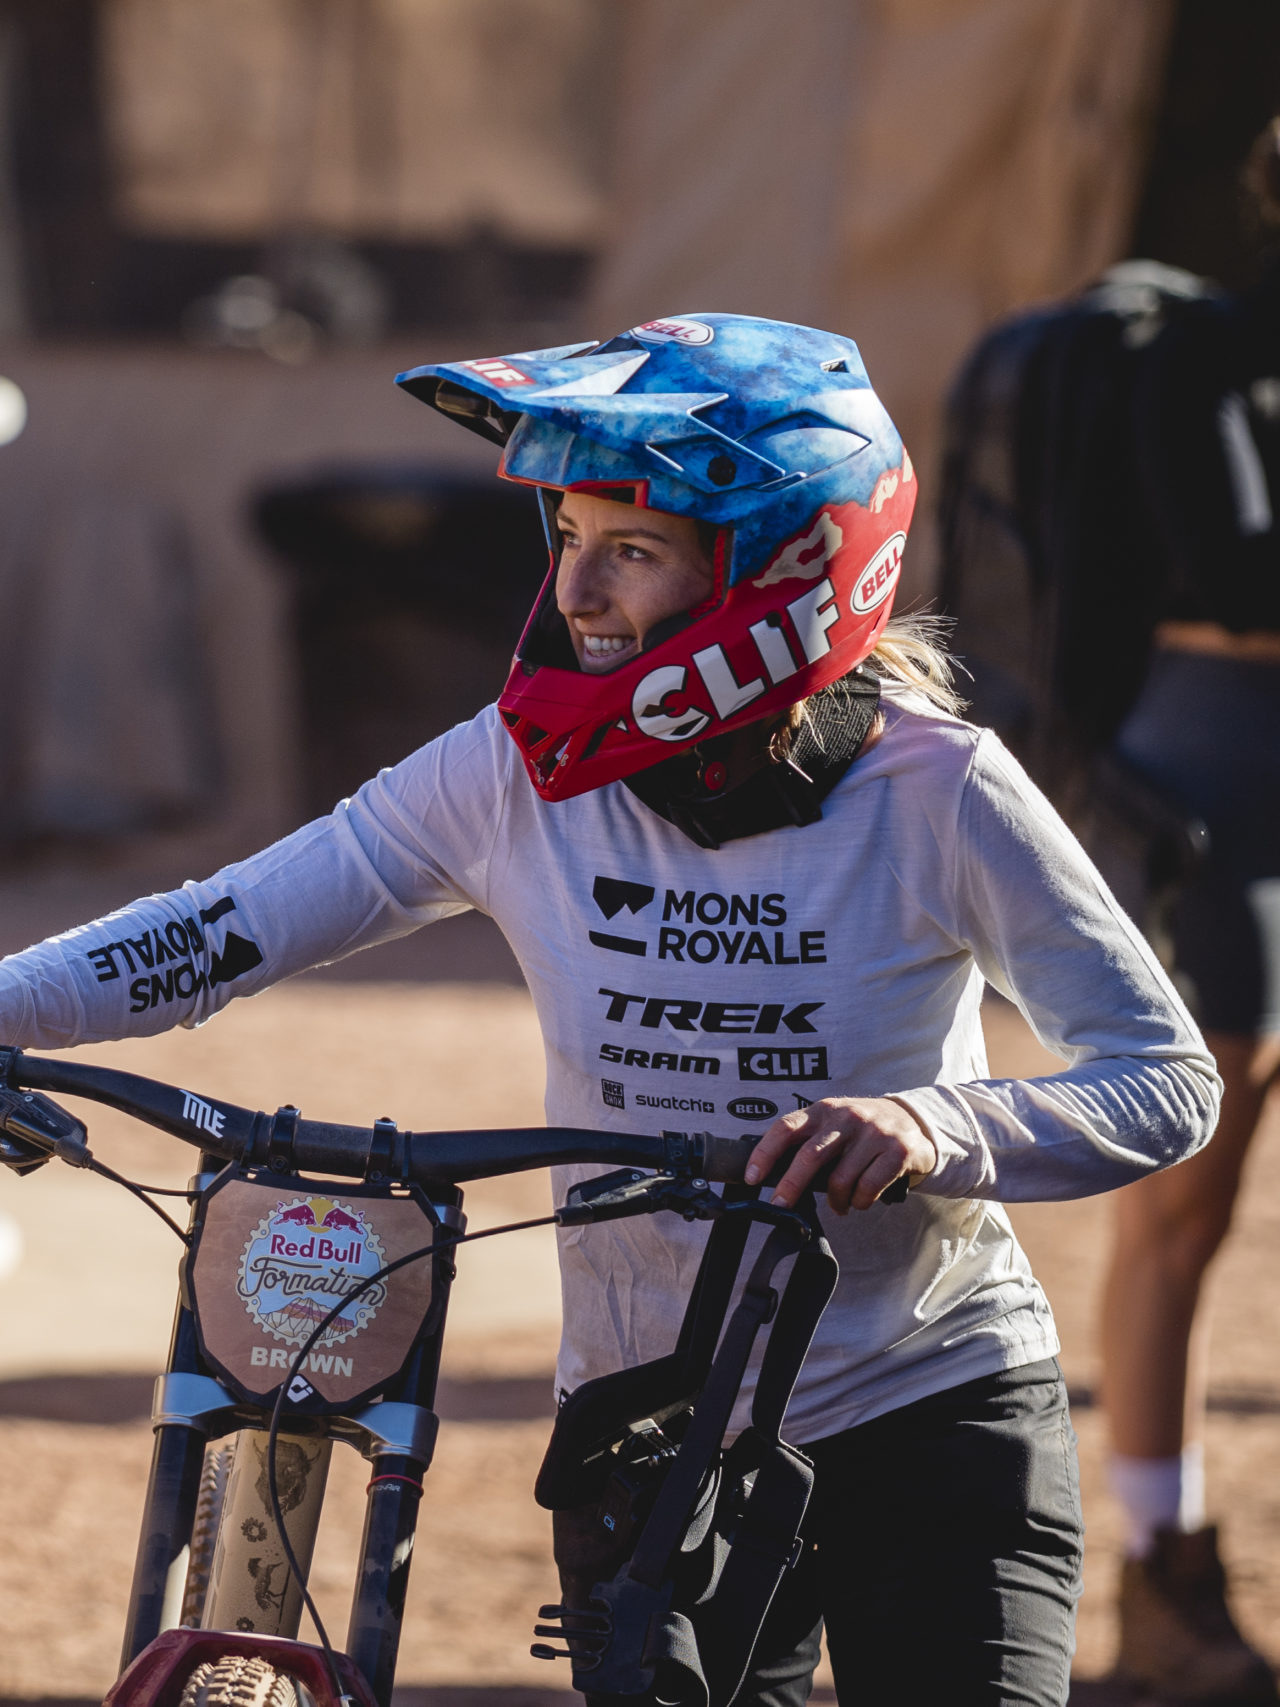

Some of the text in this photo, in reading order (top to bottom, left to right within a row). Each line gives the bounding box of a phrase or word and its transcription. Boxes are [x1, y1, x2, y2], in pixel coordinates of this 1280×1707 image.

[861, 546, 902, 604] BELL
[631, 578, 840, 742] CLIF
[662, 889, 787, 927] MONS
[87, 917, 205, 982] ROYALE
[658, 926, 827, 965] ROYALE
[598, 988, 826, 1034] TREK
[599, 1043, 720, 1075] SRAM
[749, 1051, 821, 1076] CLIF
[735, 1103, 770, 1114] BELL
[270, 1234, 362, 1264] Red Bull
[250, 1346, 354, 1377] BROWN
